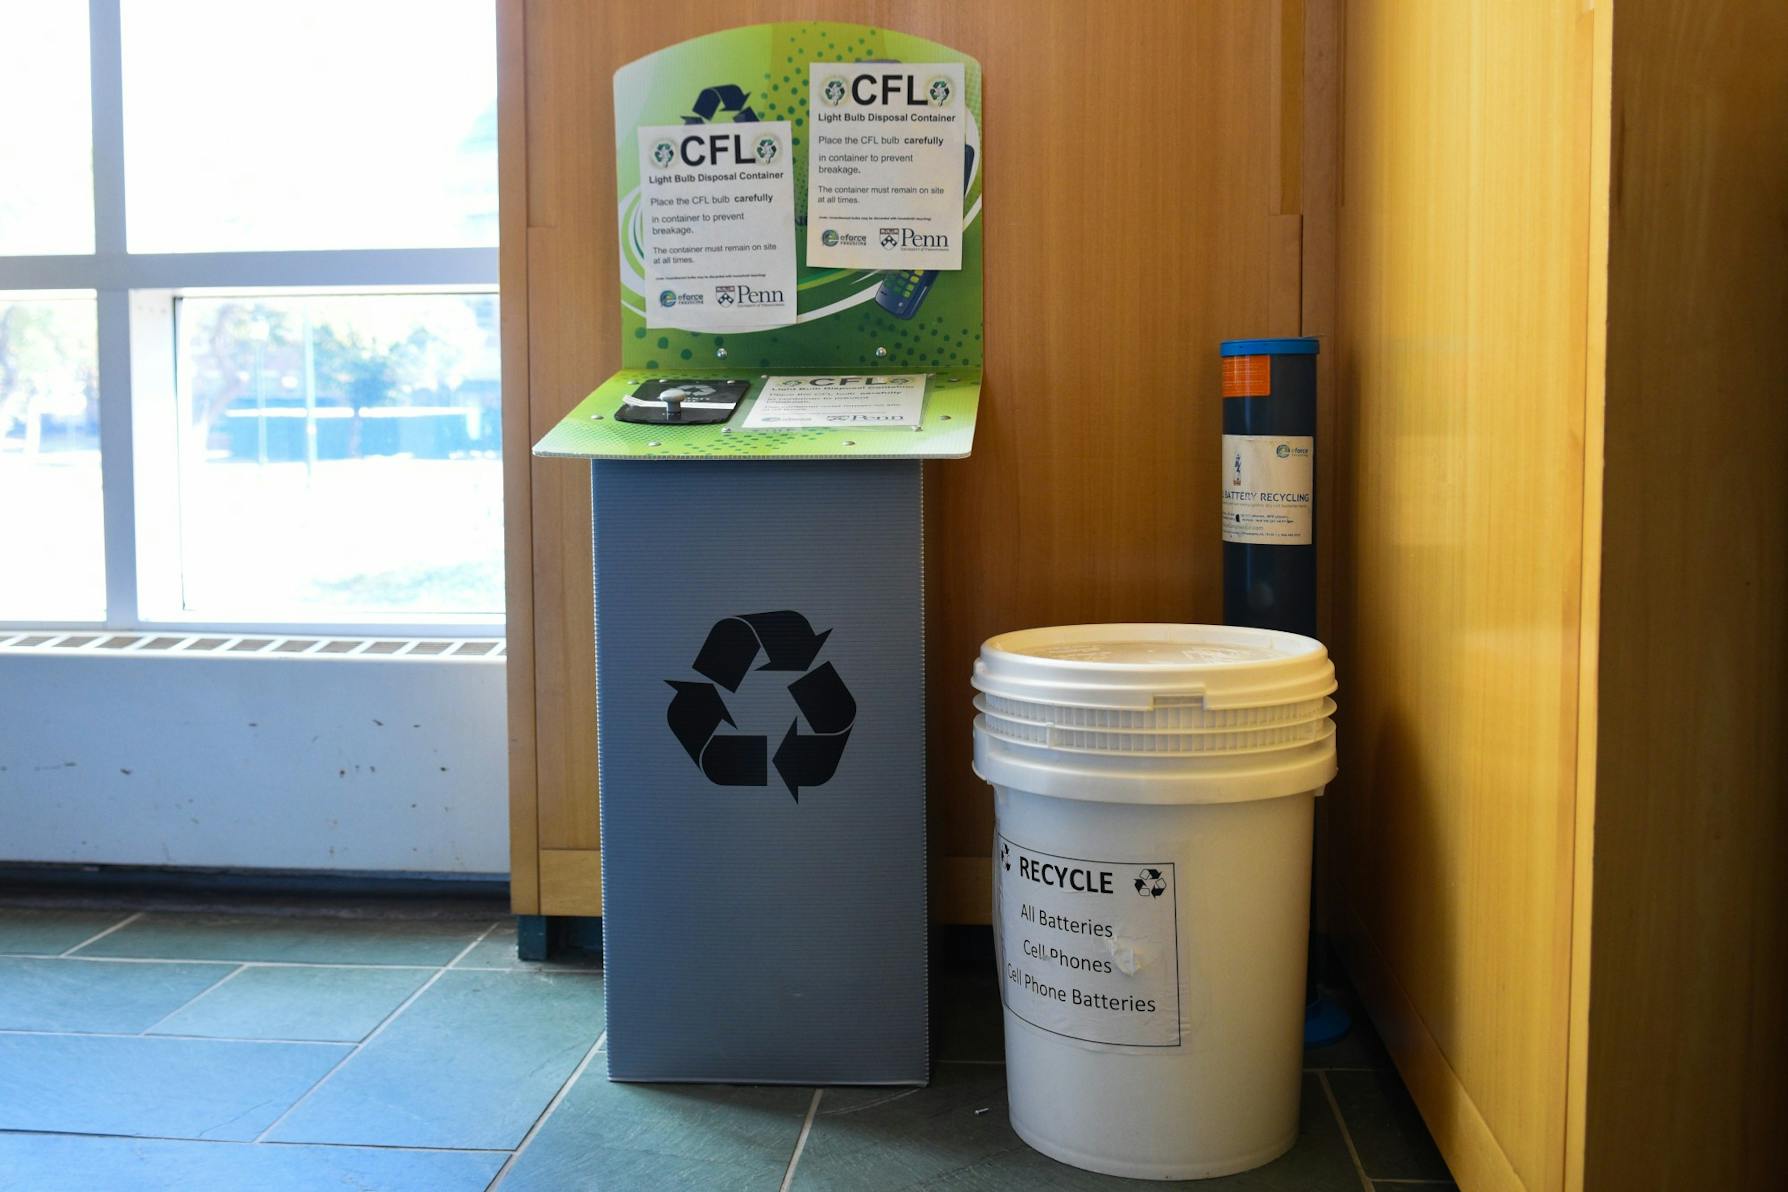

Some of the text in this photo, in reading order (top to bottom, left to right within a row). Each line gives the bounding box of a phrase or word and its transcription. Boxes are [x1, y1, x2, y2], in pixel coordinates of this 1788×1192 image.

[851, 74, 928, 106] CFL
[818, 113, 956, 123] Light Bulb Disposal Container
[818, 136, 944, 147] Place the CFL bulb carefully
[680, 134, 756, 166] CFL
[819, 153, 913, 164] in container to prevent
[818, 166, 861, 176] breakage.
[649, 172, 784, 186] Light Bulb Disposal Container
[818, 185, 833, 194] The
[834, 186, 869, 194] container
[871, 186, 889, 194] must
[891, 186, 917, 194] remain
[930, 186, 944, 194] site
[651, 194, 774, 206] Place the CFL bulb carefully
[652, 215, 659, 223] in
[661, 214, 700, 223] container
[713, 213, 744, 222] prevent
[652, 226, 694, 236] breakage.
[902, 228, 948, 248] Penn
[653, 246, 667, 254] The
[669, 246, 703, 254] container
[705, 245, 723, 253] must
[725, 244, 750, 252] remain
[662, 256, 670, 264] all
[738, 285, 784, 304] Penn
[809, 377, 887, 386] CFL
[1260, 492, 1309, 502] RECYCLING
[1019, 856, 1114, 894] RECYCLE
[1020, 904, 1113, 938] All Batteries
[1023, 940, 1112, 974] Cell Phones
[1007, 963, 1156, 1012] Cell Phone Batteries
